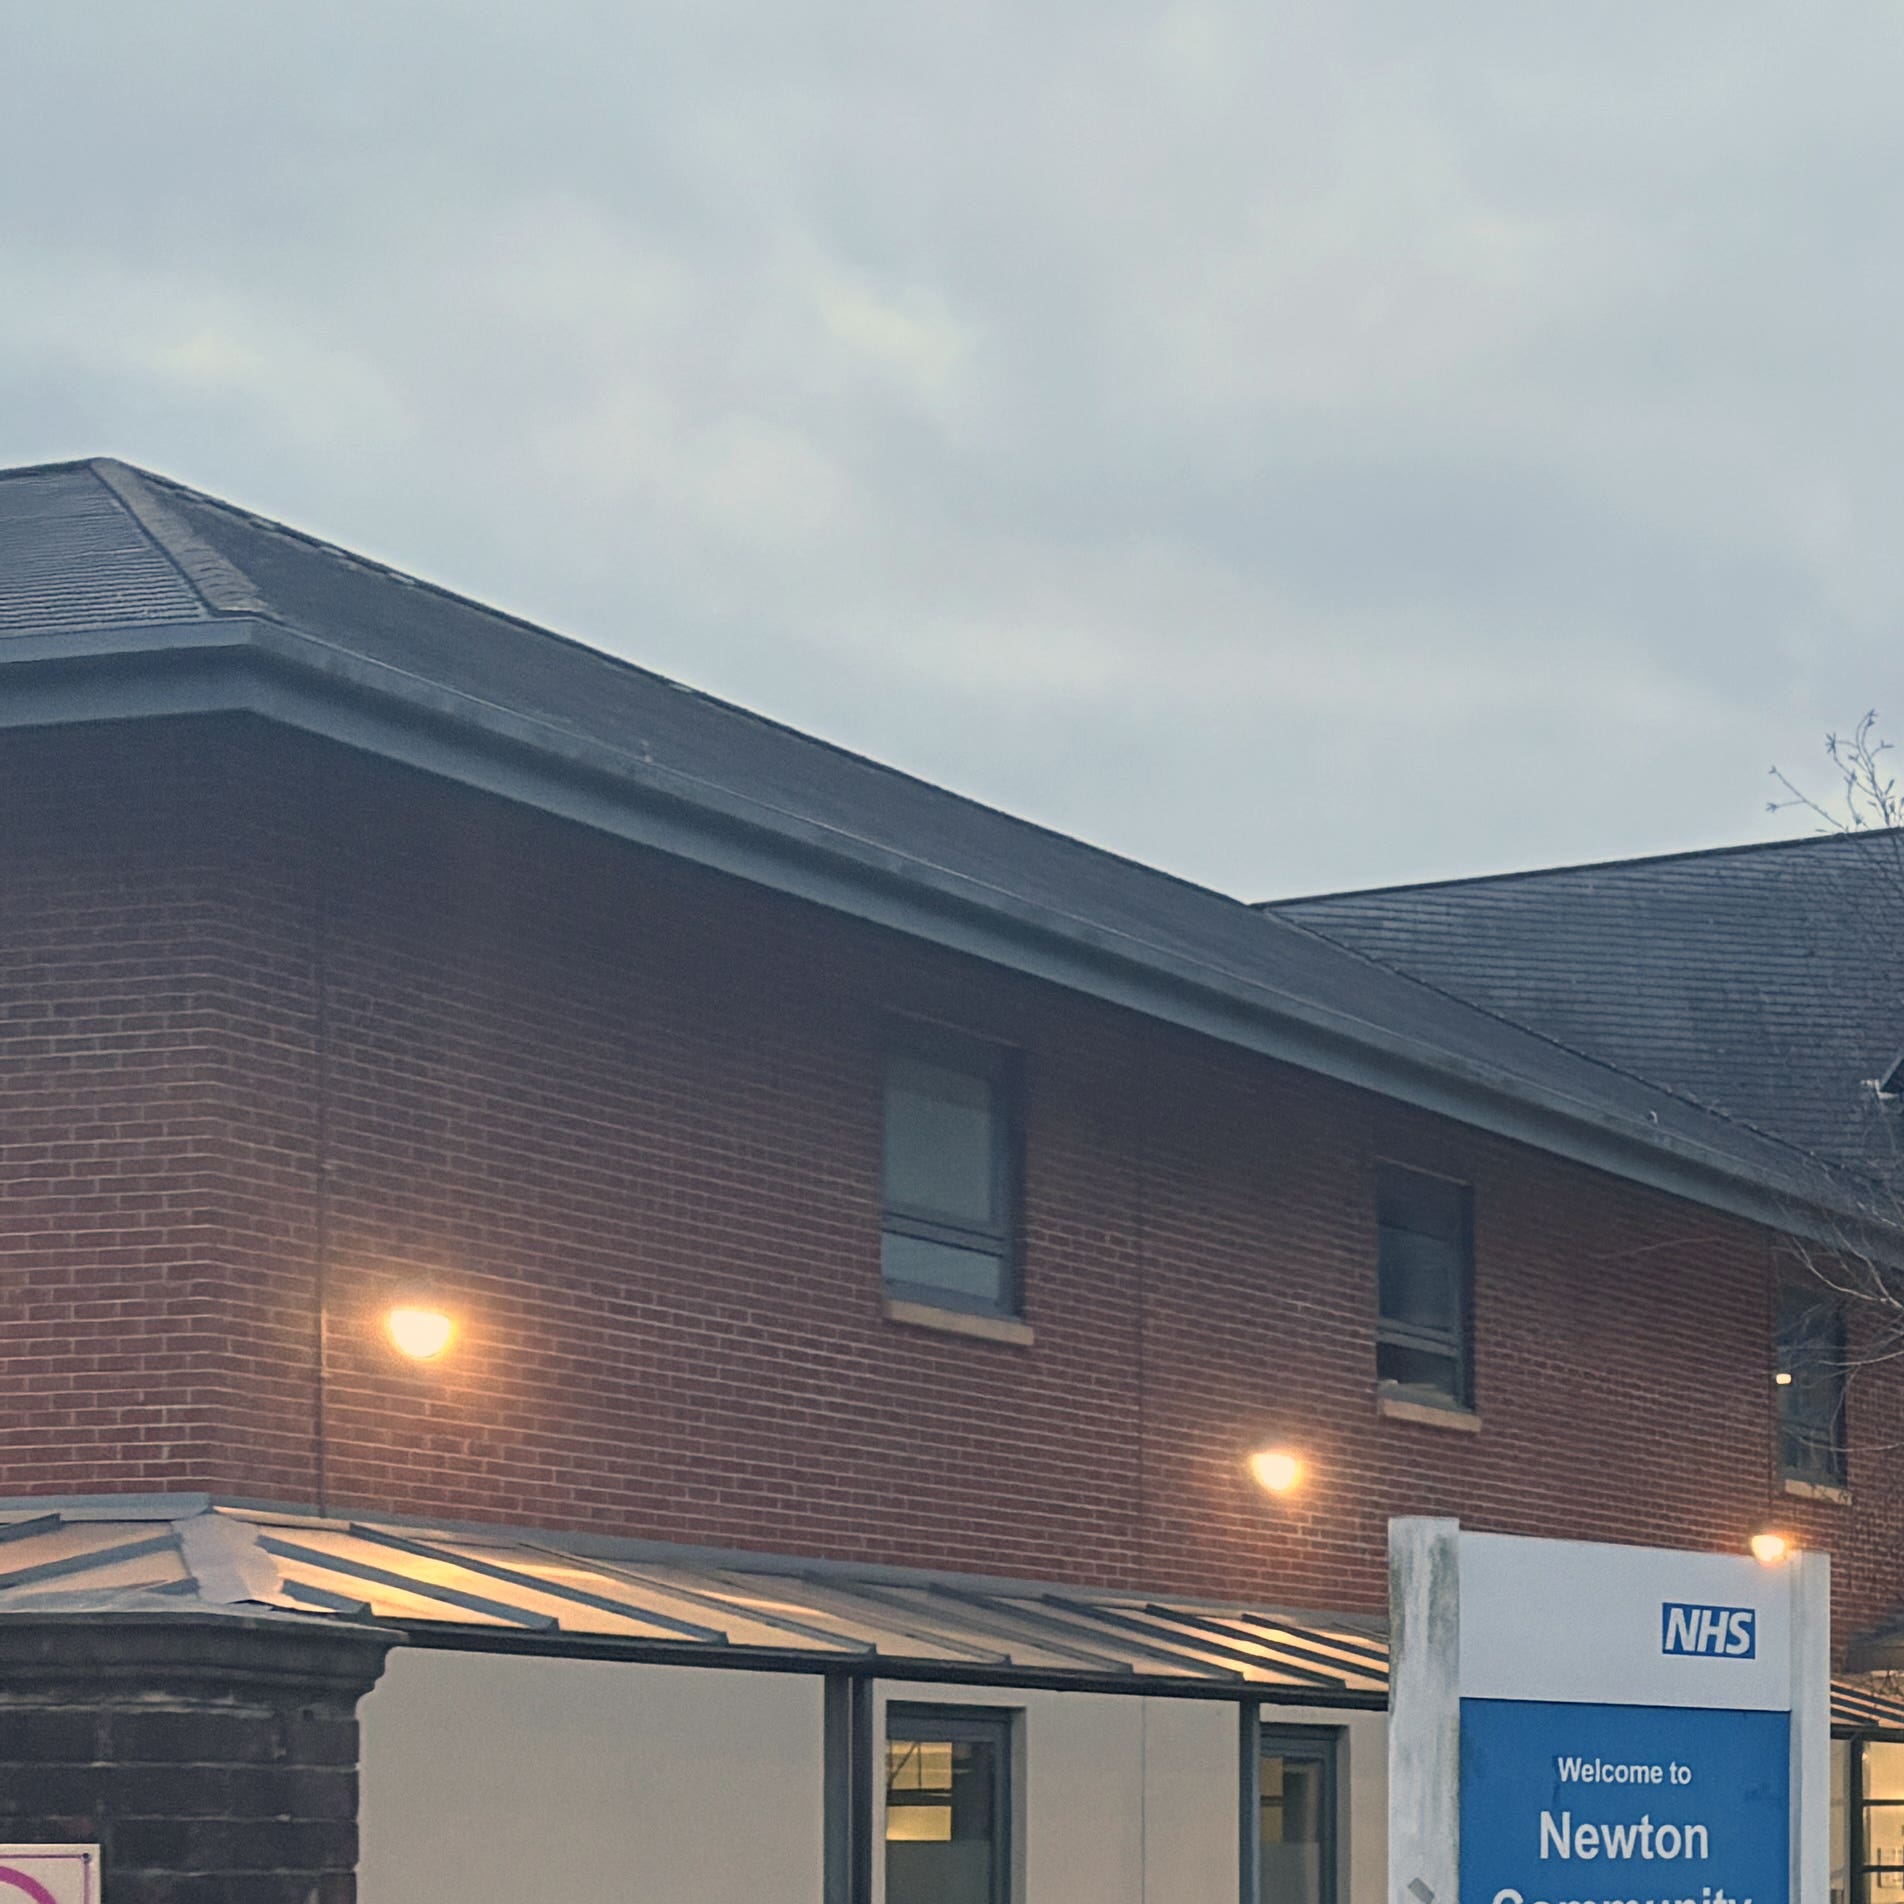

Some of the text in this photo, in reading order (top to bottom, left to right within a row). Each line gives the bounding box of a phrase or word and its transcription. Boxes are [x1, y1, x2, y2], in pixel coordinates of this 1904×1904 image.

[1664, 1606, 1754, 1656] NHS
[1557, 1756, 1692, 1785] Welcome to
[1539, 1810, 1709, 1860] Newton
